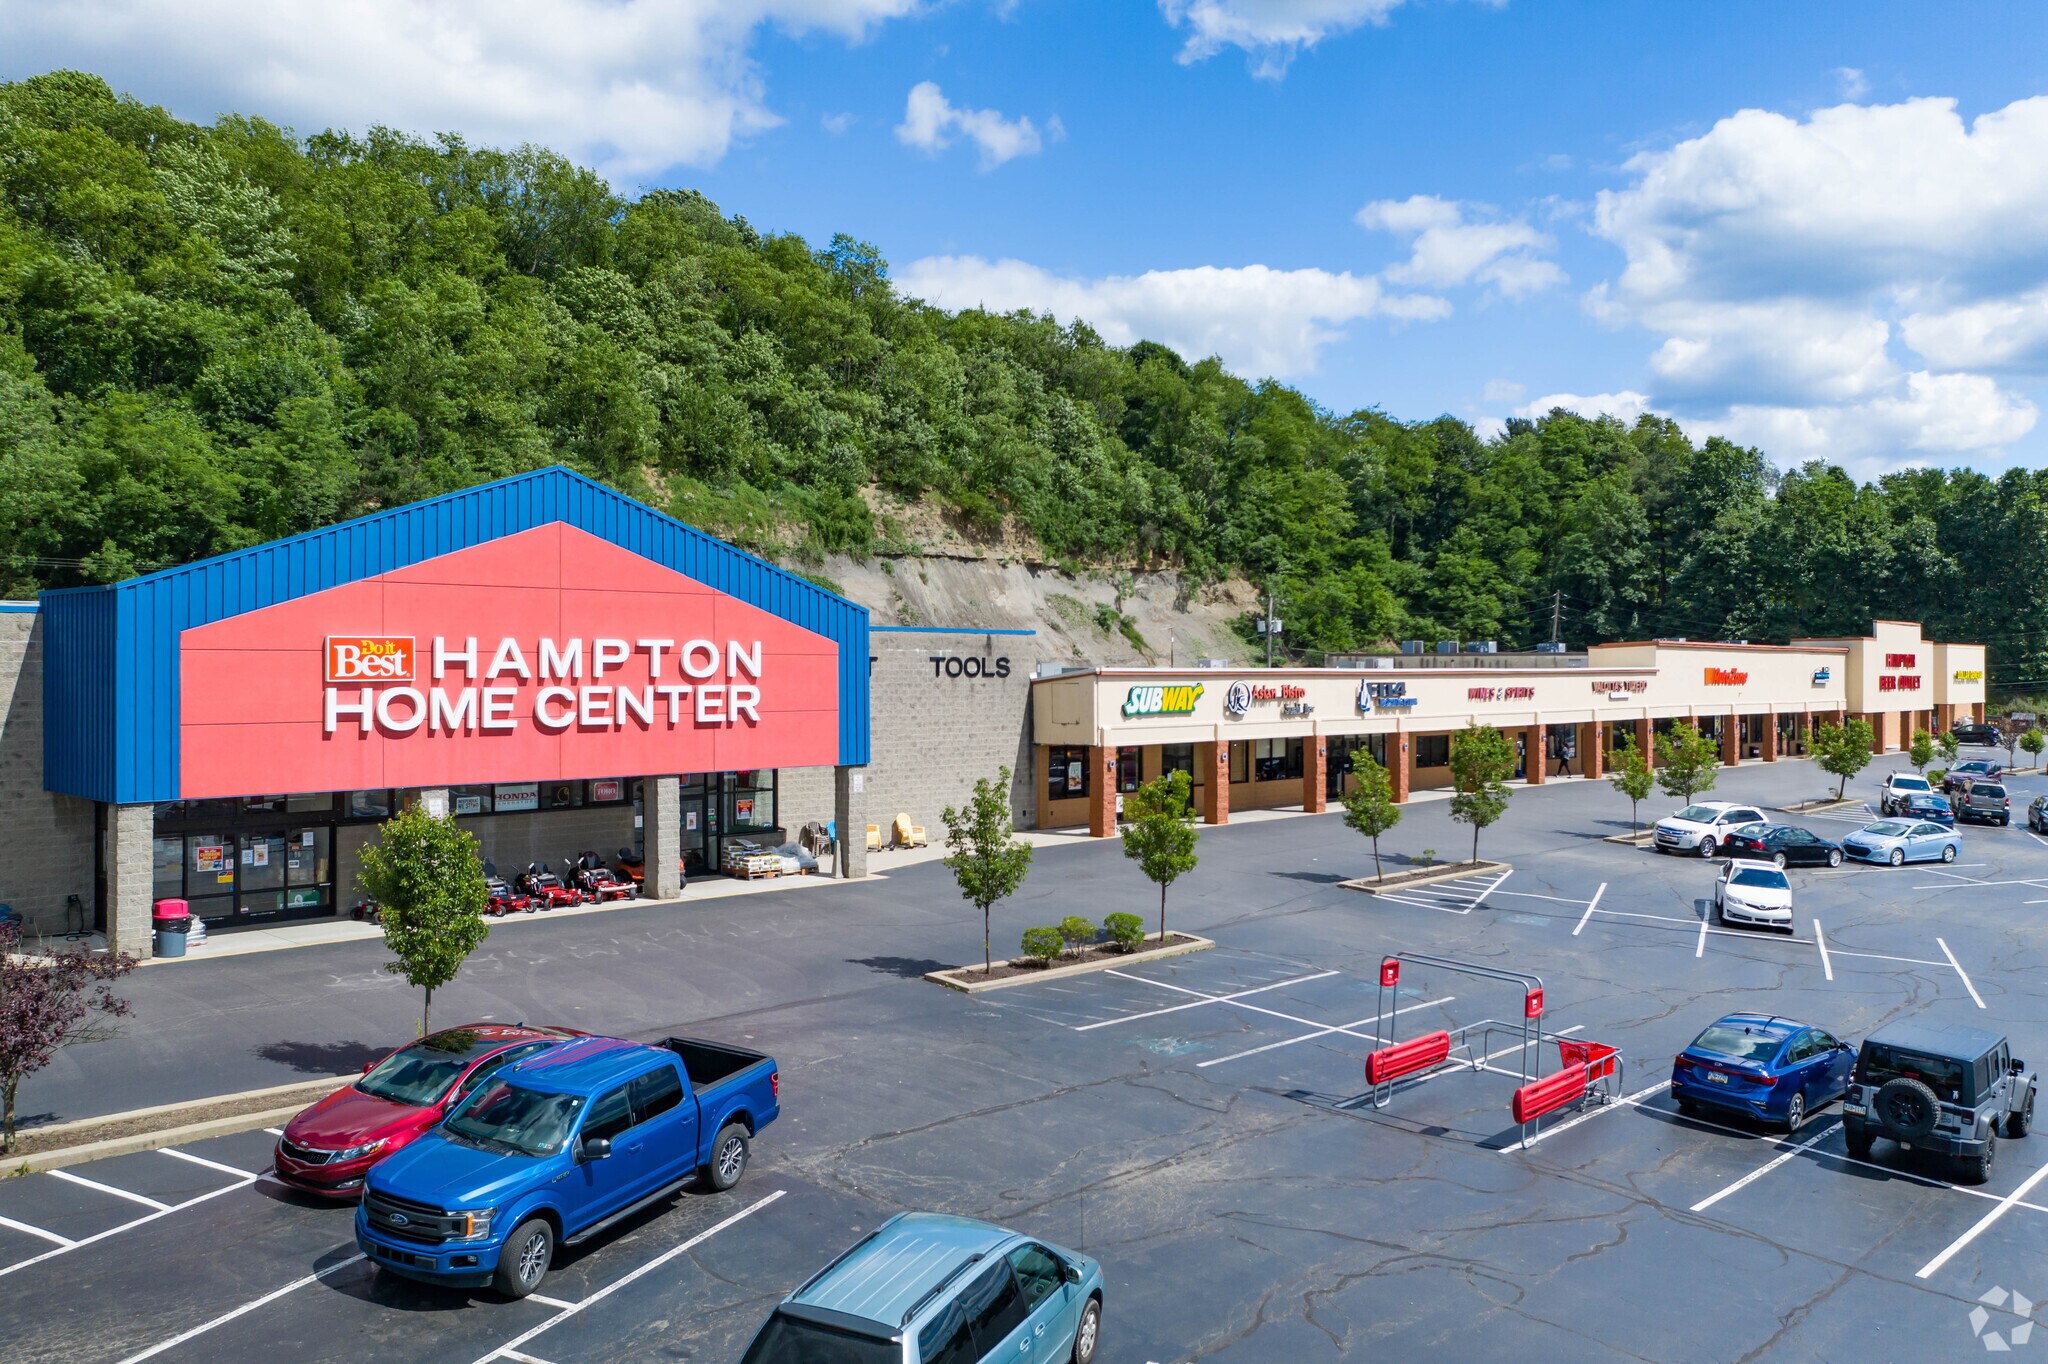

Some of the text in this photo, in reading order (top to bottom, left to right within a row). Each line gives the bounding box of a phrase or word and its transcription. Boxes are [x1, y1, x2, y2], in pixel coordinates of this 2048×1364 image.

[361, 640, 397, 655] Do it
[432, 636, 762, 679] HAMPTON
[333, 644, 407, 677] Best
[929, 656, 1011, 679] TOOLS
[1125, 683, 1204, 716] SUBWAY
[1251, 684, 1306, 700] Asian Bistro
[1468, 687, 1495, 700] WINES
[1504, 686, 1535, 699] SPIRITS
[324, 684, 761, 732] HOME CENTER
[495, 792, 537, 801] HONDA
